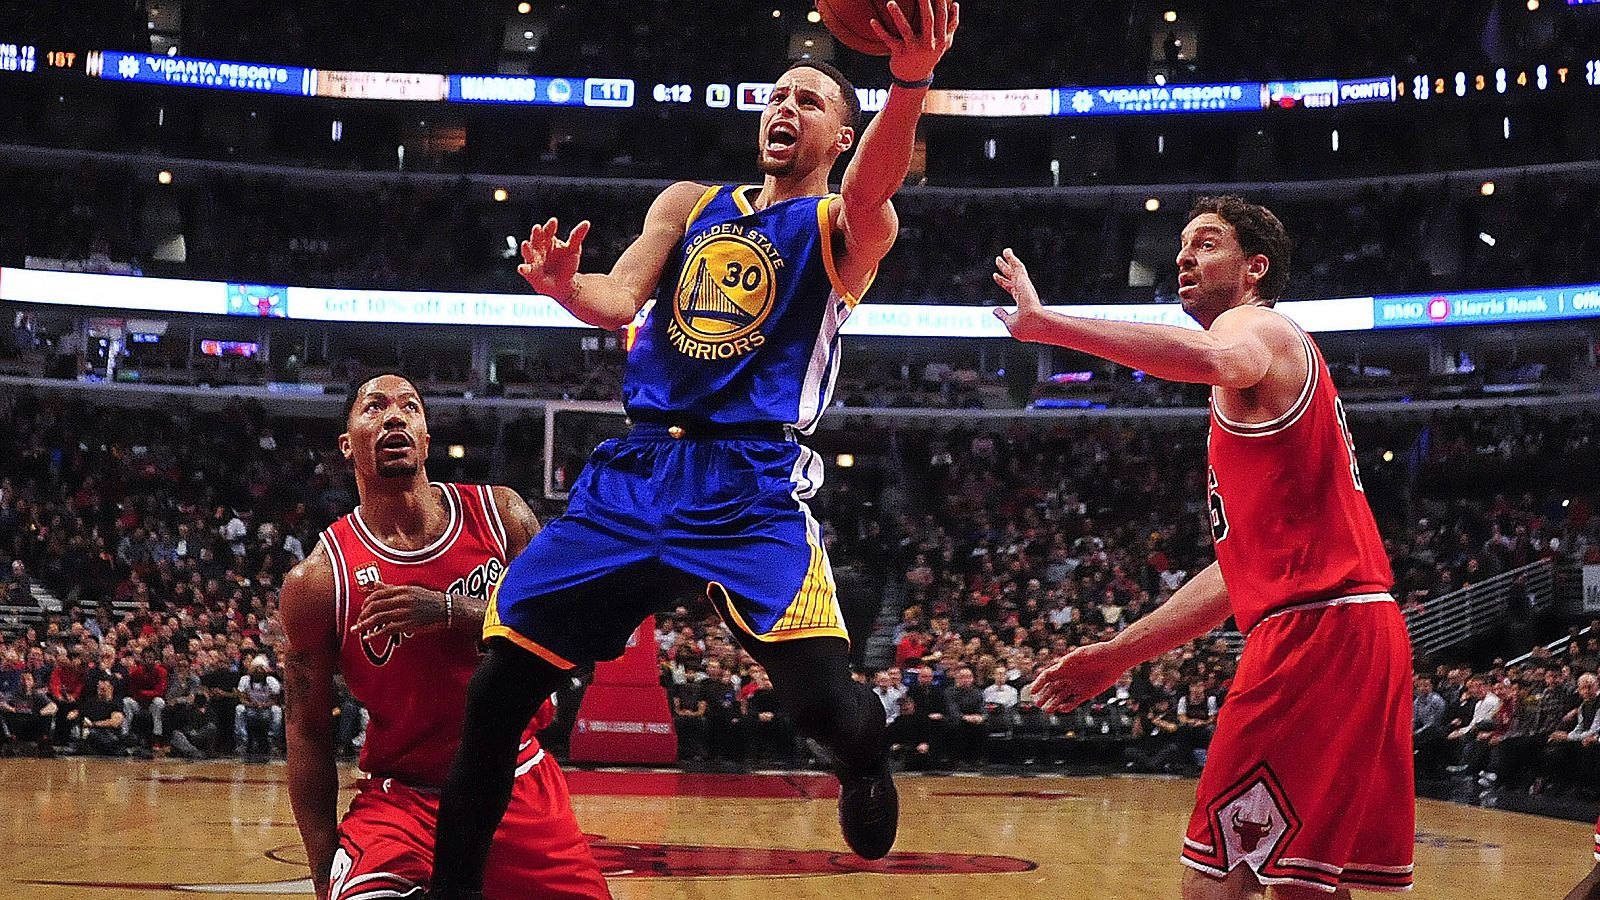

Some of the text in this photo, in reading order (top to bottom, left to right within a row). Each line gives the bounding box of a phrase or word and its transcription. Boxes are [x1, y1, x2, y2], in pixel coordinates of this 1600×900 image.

[600, 82, 622, 100] 11
[652, 83, 692, 103] 6:12
[685, 223, 786, 270] GOLDEN STATE
[721, 261, 763, 292] 30
[666, 318, 767, 361] WARRIORS
[355, 565, 381, 586] 50
